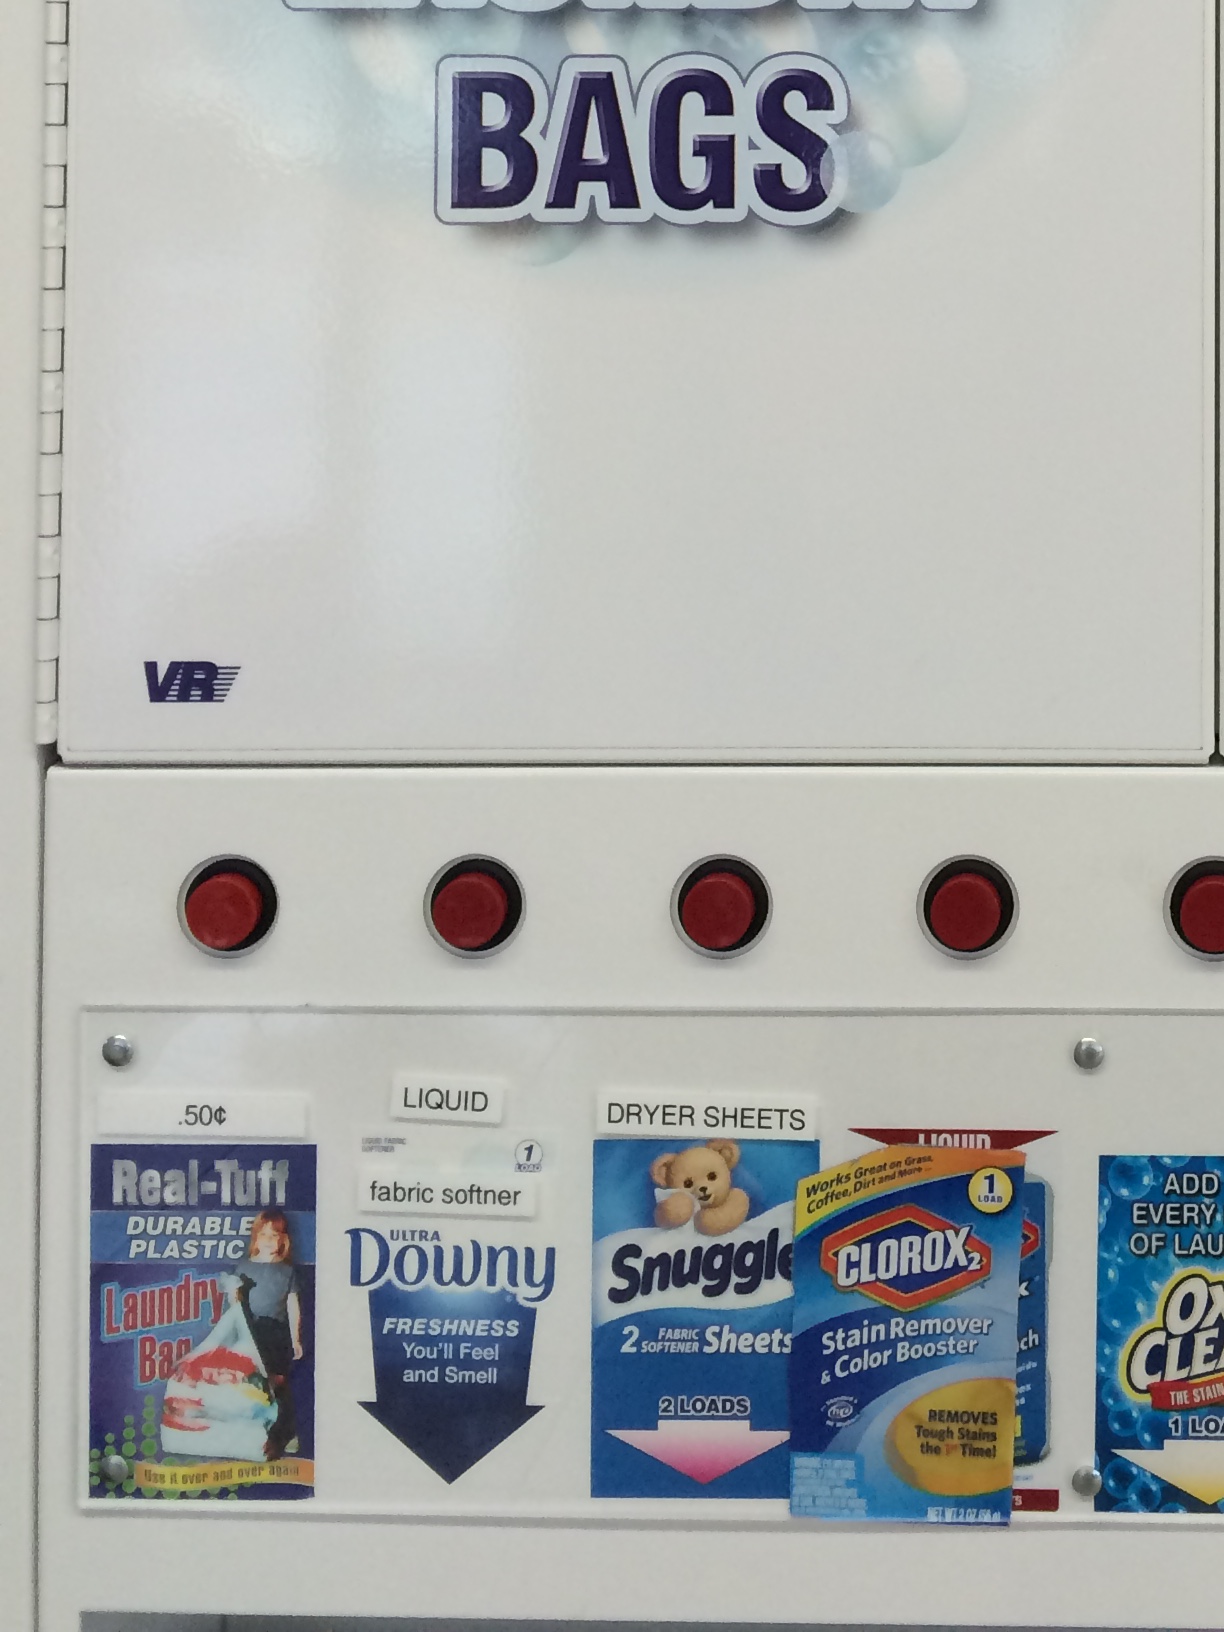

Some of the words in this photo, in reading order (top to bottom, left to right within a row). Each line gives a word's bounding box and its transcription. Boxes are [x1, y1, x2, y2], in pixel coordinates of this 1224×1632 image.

[442, 61, 842, 215] BAGS
[403, 1087, 488, 1112] LIQUID
[178, 1104, 227, 1126] .50¢
[607, 1102, 695, 1126] DRYER
[703, 1106, 806, 1131] SHEETS
[523, 1144, 534, 1162] 1
[514, 1163, 542, 1172] LOAD
[806, 1172, 852, 1198] Works
[854, 1163, 888, 1179] Great
[888, 1159, 902, 1169] on
[111, 1158, 290, 1207] Real-Tuff
[370, 1180, 434, 1204] fabric
[441, 1183, 521, 1206] softner
[806, 1188, 852, 1214] Coffee,
[853, 1178, 876, 1194] Dirt
[877, 1171, 896, 1185] and
[983, 1174, 995, 1195] 1
[1164, 1172, 1219, 1195] ADD
[977, 1195, 1003, 1204] LOAD
[1132, 1203, 1216, 1225] EVERY
[126, 1216, 254, 1236] DURABLE
[389, 1229, 441, 1242] ULTRA
[129, 1239, 245, 1259] PLASTIC
[1129, 1233, 1166, 1255] OF
[344, 1227, 556, 1303] Downy
[607, 1227, 793, 1304] Snuggle
[104, 1272, 224, 1335] Laundry
[382, 1317, 520, 1337] FRESHNESS
[658, 1327, 699, 1340] FABRIC
[821, 1320, 887, 1355] Stain
[889, 1316, 993, 1340] Remover
[620, 1324, 640, 1354] 2
[641, 1340, 699, 1354] SOFTENER
[702, 1324, 793, 1354] Sheets
[402, 1341, 453, 1360] You'll
[459, 1342, 499, 1361] Feel
[820, 1369, 831, 1385] &
[834, 1348, 893, 1379] Color
[896, 1335, 979, 1363] Booster
[402, 1366, 439, 1383] and
[444, 1366, 498, 1384] Smell
[1169, 1390, 1190, 1406] THE
[1192, 1380, 1224, 1404] STAIN
[660, 1397, 674, 1415] 2
[678, 1396, 750, 1415] LOADS
[927, 1409, 998, 1425] REMOVES
[1169, 1417, 1180, 1436] 1
[915, 1425, 954, 1442] Tough
[957, 1426, 997, 1443] Stains
[919, 1441, 941, 1455] the
[960, 1443, 997, 1458] Time!
